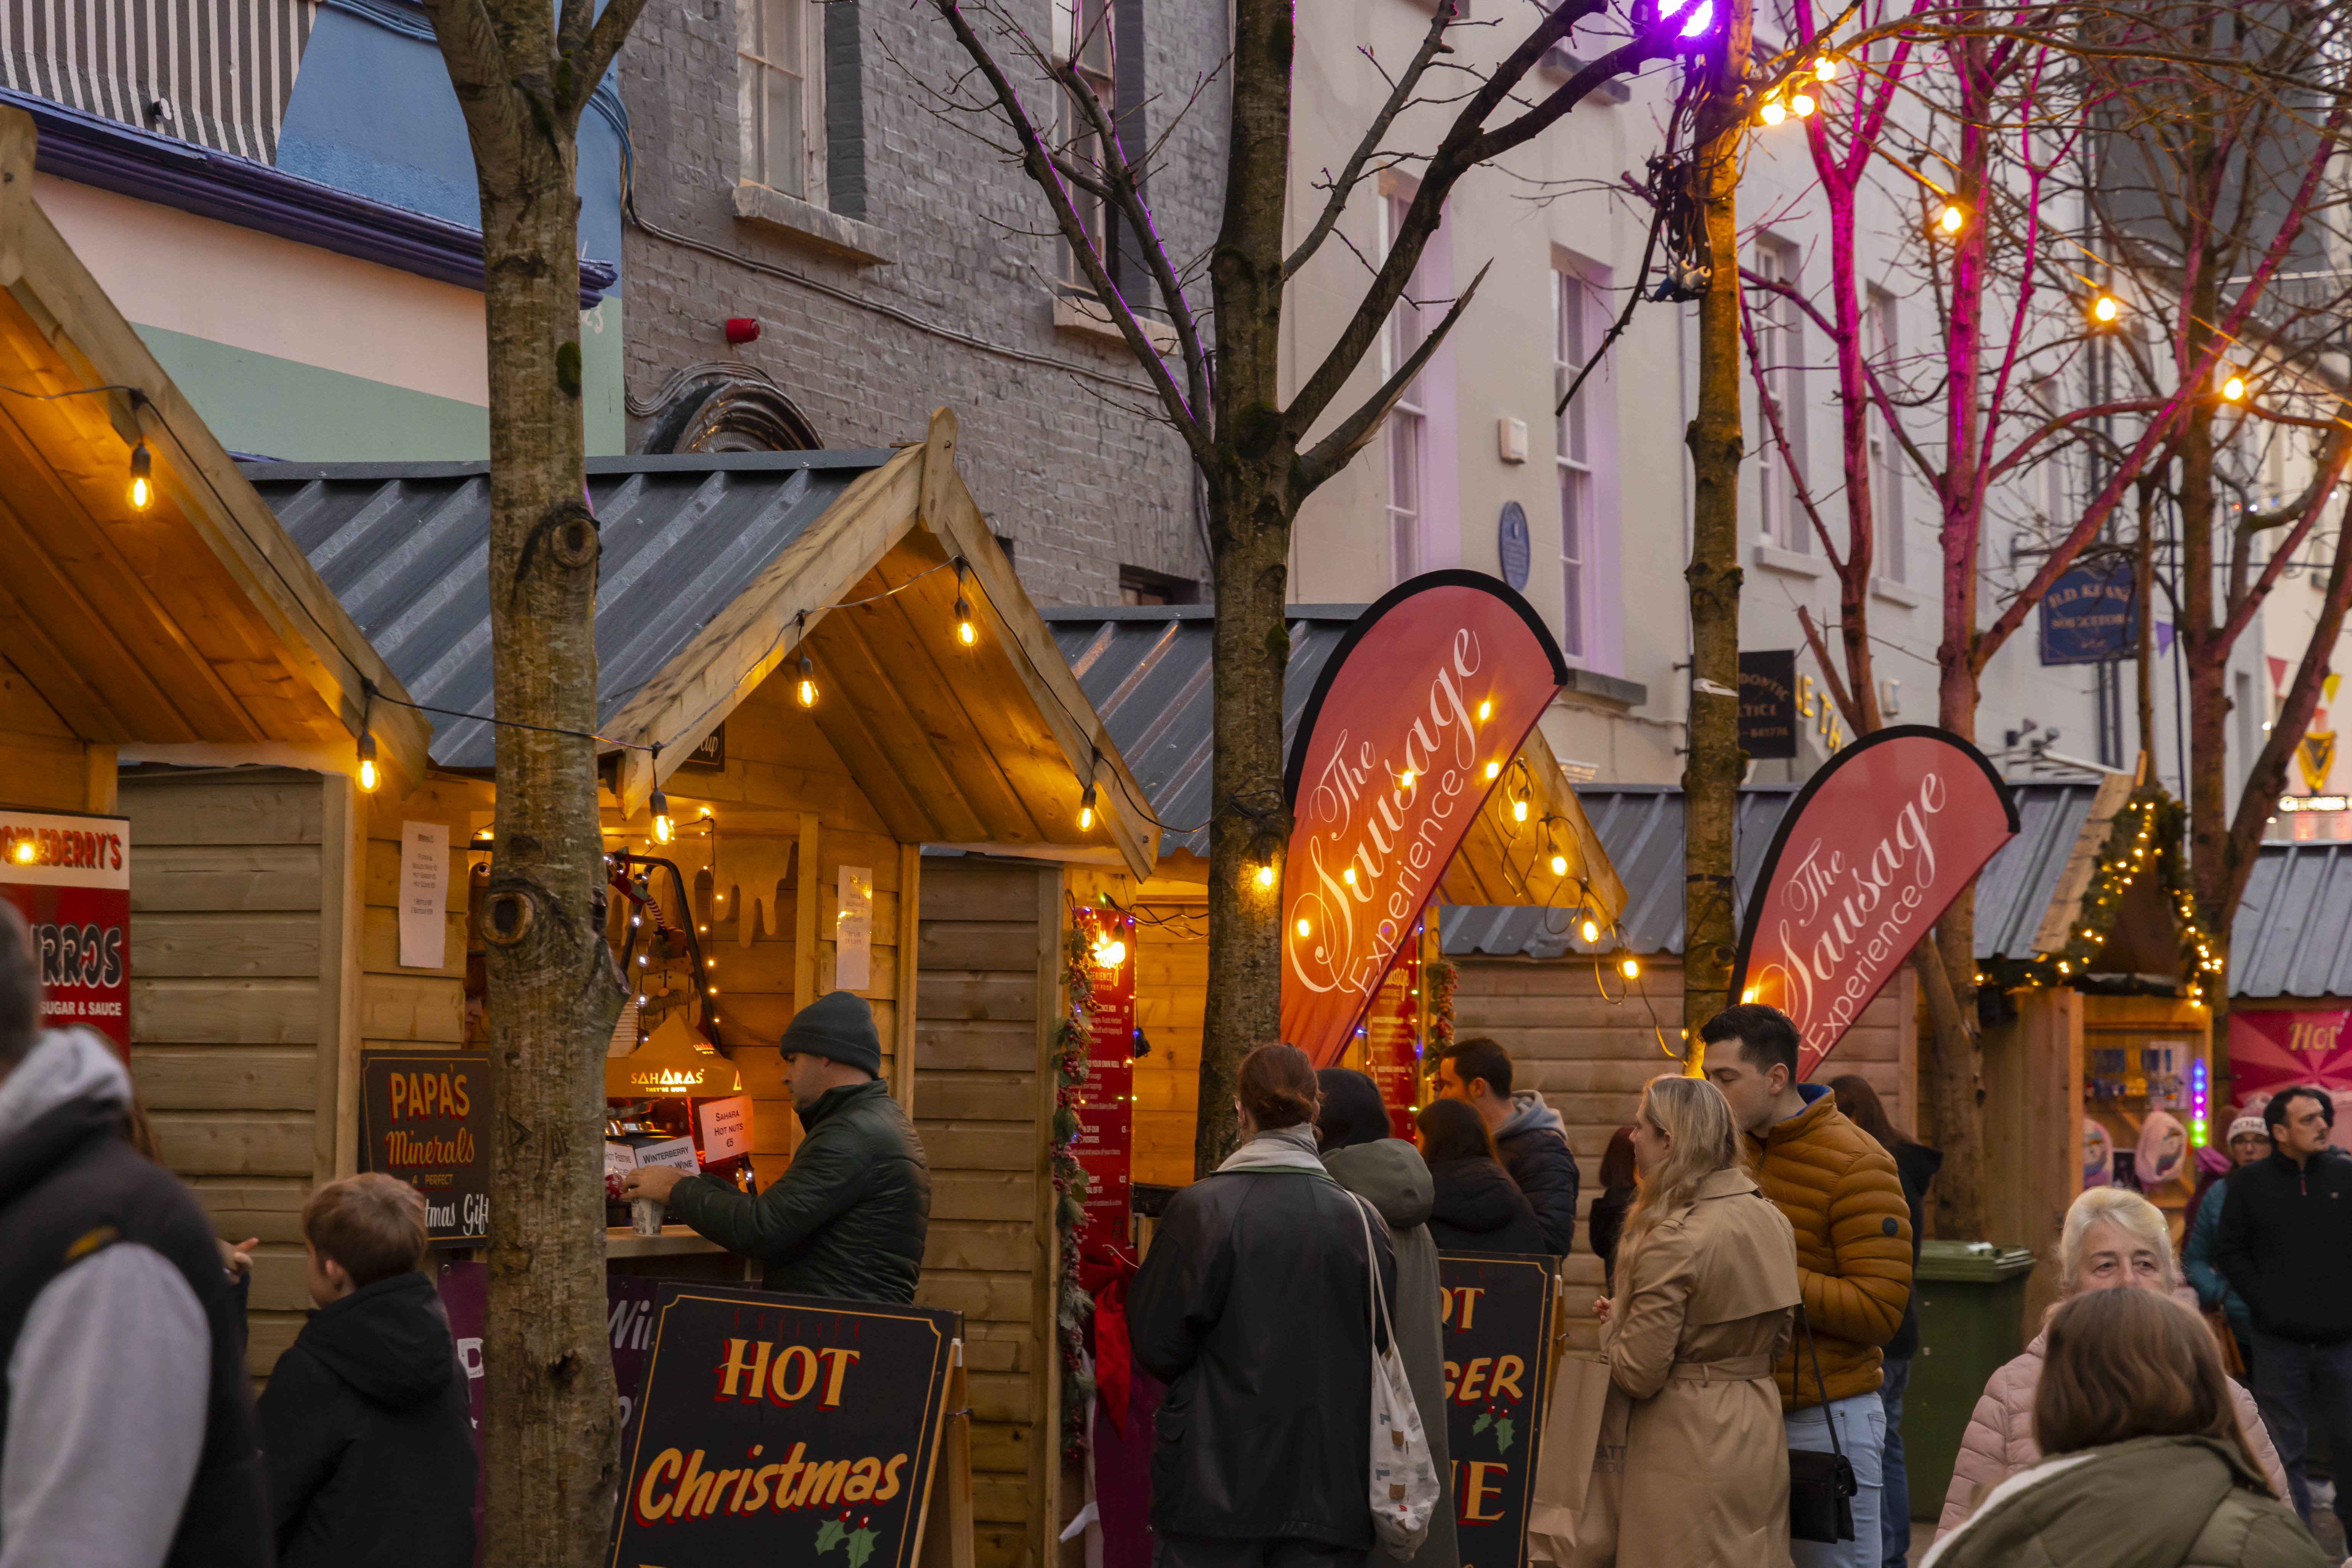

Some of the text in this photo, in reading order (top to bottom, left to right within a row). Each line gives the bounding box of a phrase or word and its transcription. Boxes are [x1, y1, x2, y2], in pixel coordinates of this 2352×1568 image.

[1289, 628, 1481, 993] Sausage
[1310, 729, 1376, 840] The
[1349, 769, 1463, 998] Experience
[1757, 773, 1946, 1051] Sausage
[1781, 838, 1846, 927] The
[1805, 884, 1922, 1057] Experience
[78, 1001, 86, 1015] &
[88, 1001, 122, 1016] SAUCE
[389, 1063, 470, 1125] PAPA'S
[631, 1068, 704, 1084] SAHARAS
[714, 1123, 743, 1136] HOT NUTS
[716, 1110, 740, 1122] SAHARA
[384, 1127, 475, 1169] Minerals
[642, 1146, 689, 1164] WINTERBERRY
[674, 1160, 693, 1176] WINE
[412, 1174, 454, 1186] A PERFECT
[714, 1337, 860, 1411] HOT
[634, 1442, 908, 1527] Christmas
